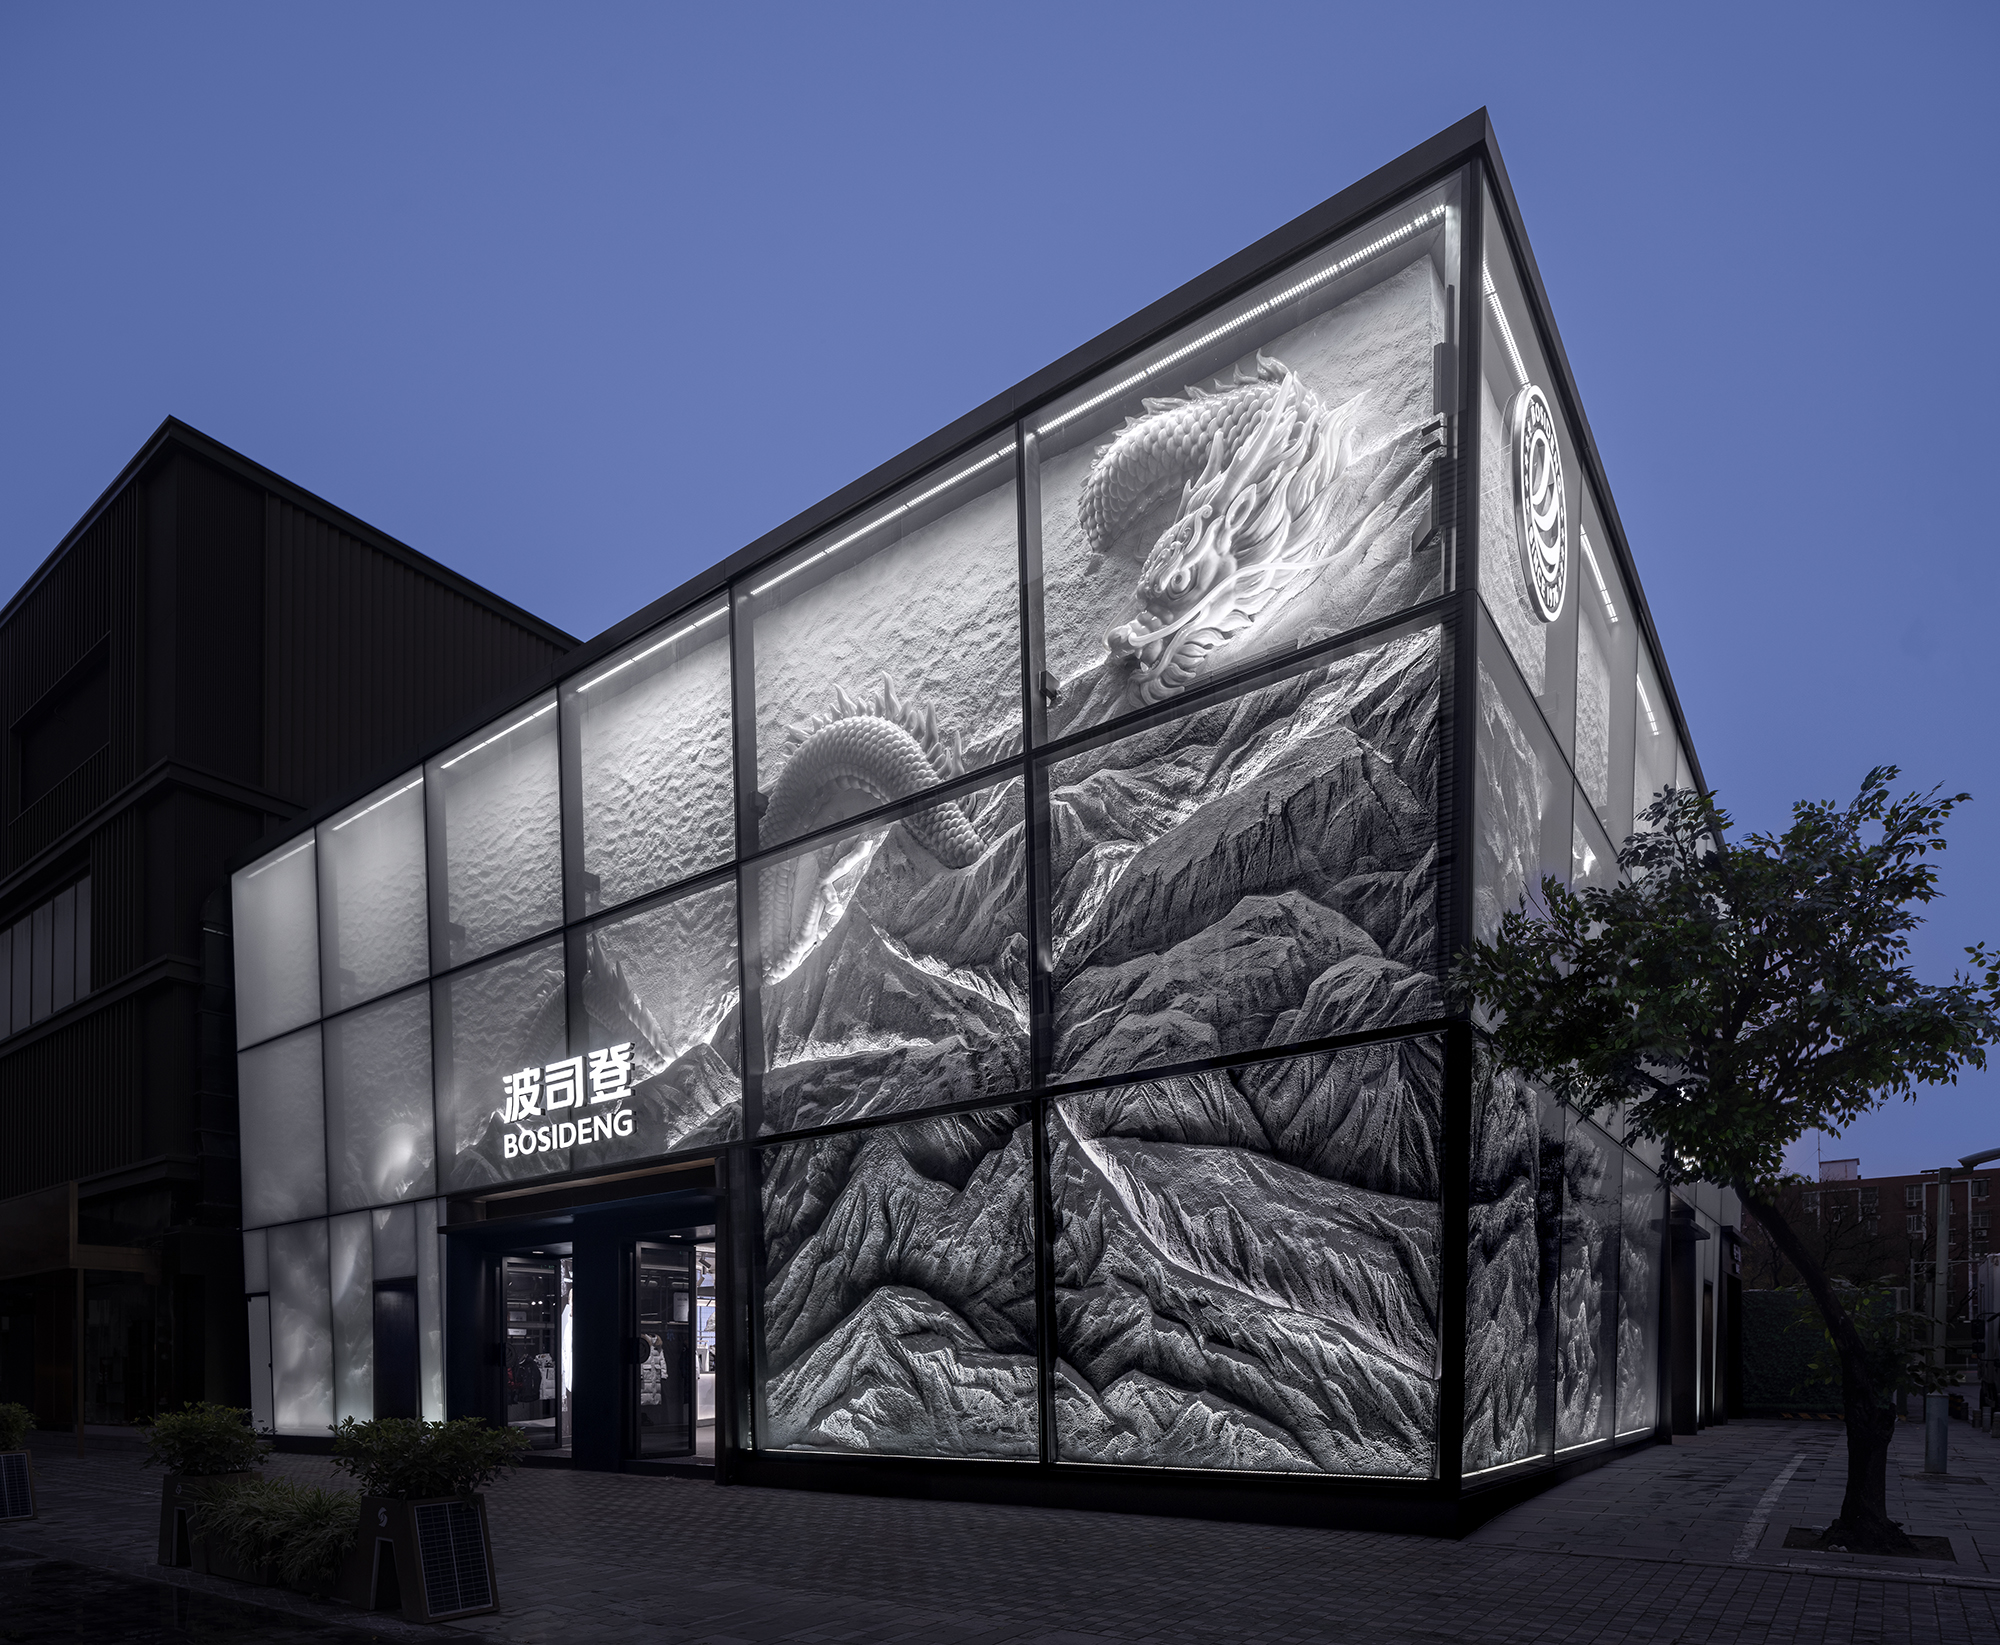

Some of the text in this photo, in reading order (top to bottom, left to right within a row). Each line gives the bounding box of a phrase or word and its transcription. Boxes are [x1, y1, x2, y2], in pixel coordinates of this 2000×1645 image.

[502, 1042, 633, 1124] 波司登
[503, 1109, 634, 1159] BOSIDENG
